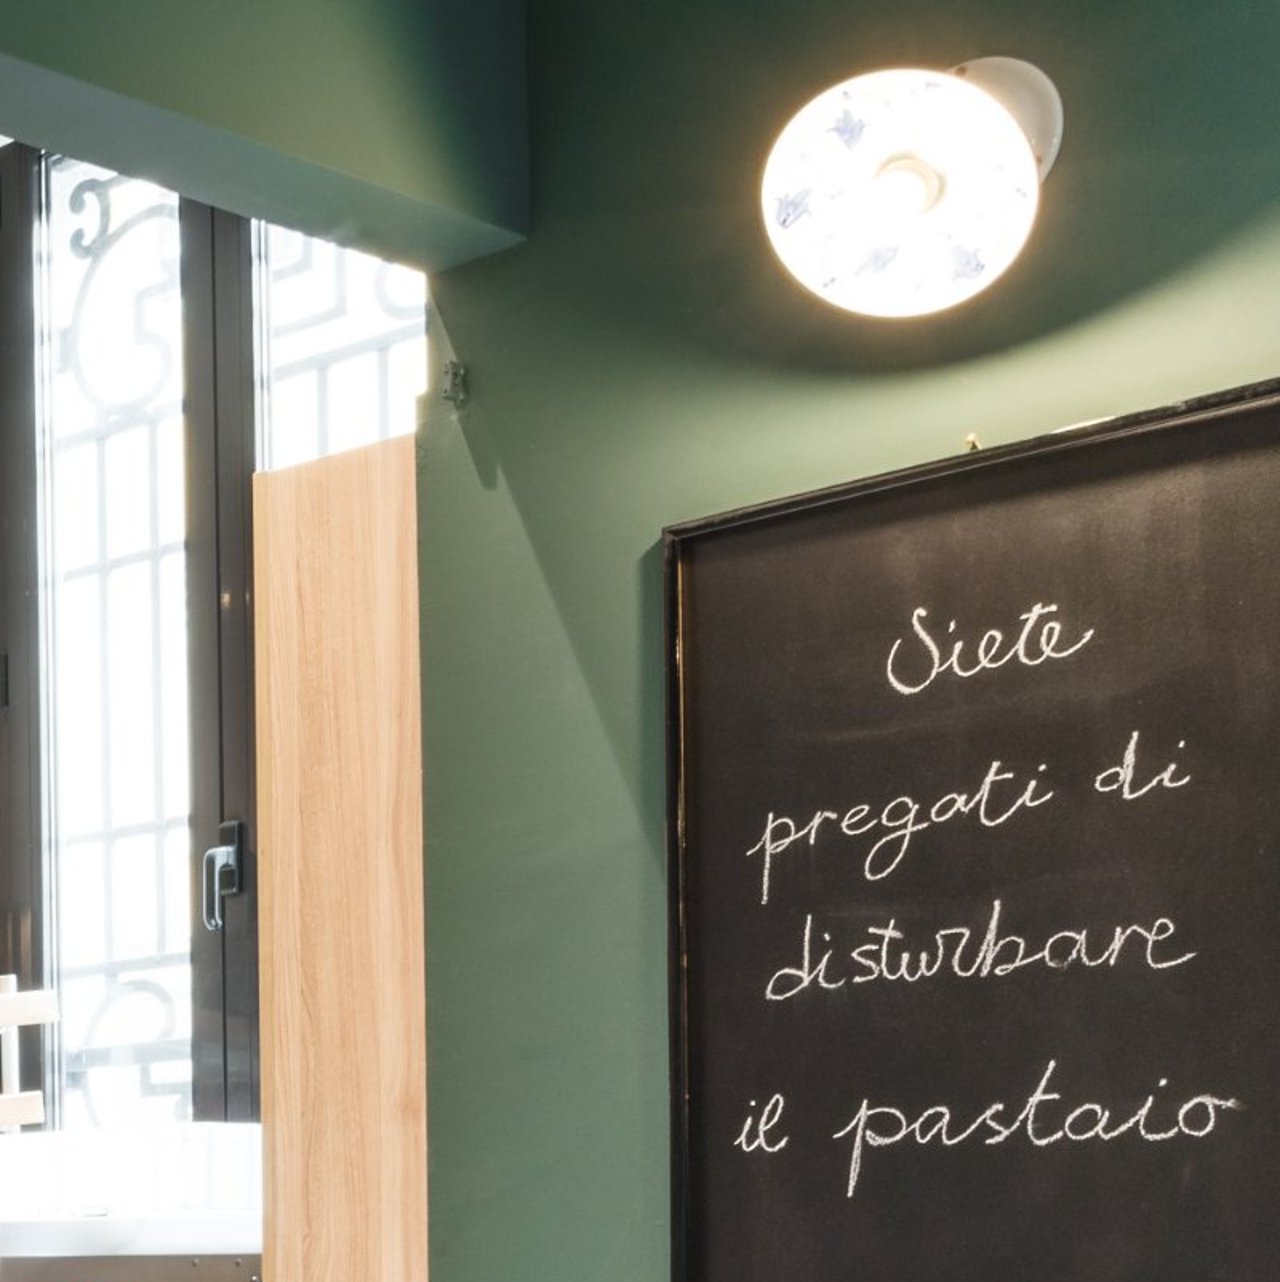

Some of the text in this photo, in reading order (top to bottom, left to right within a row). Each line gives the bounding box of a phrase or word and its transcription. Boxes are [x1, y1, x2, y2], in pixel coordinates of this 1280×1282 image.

[885, 601, 1096, 697] Siete
[745, 729, 1192, 906] pregati di
[764, 899, 1200, 1002] disturbare
[732, 1058, 1239, 1199] il pastaio
